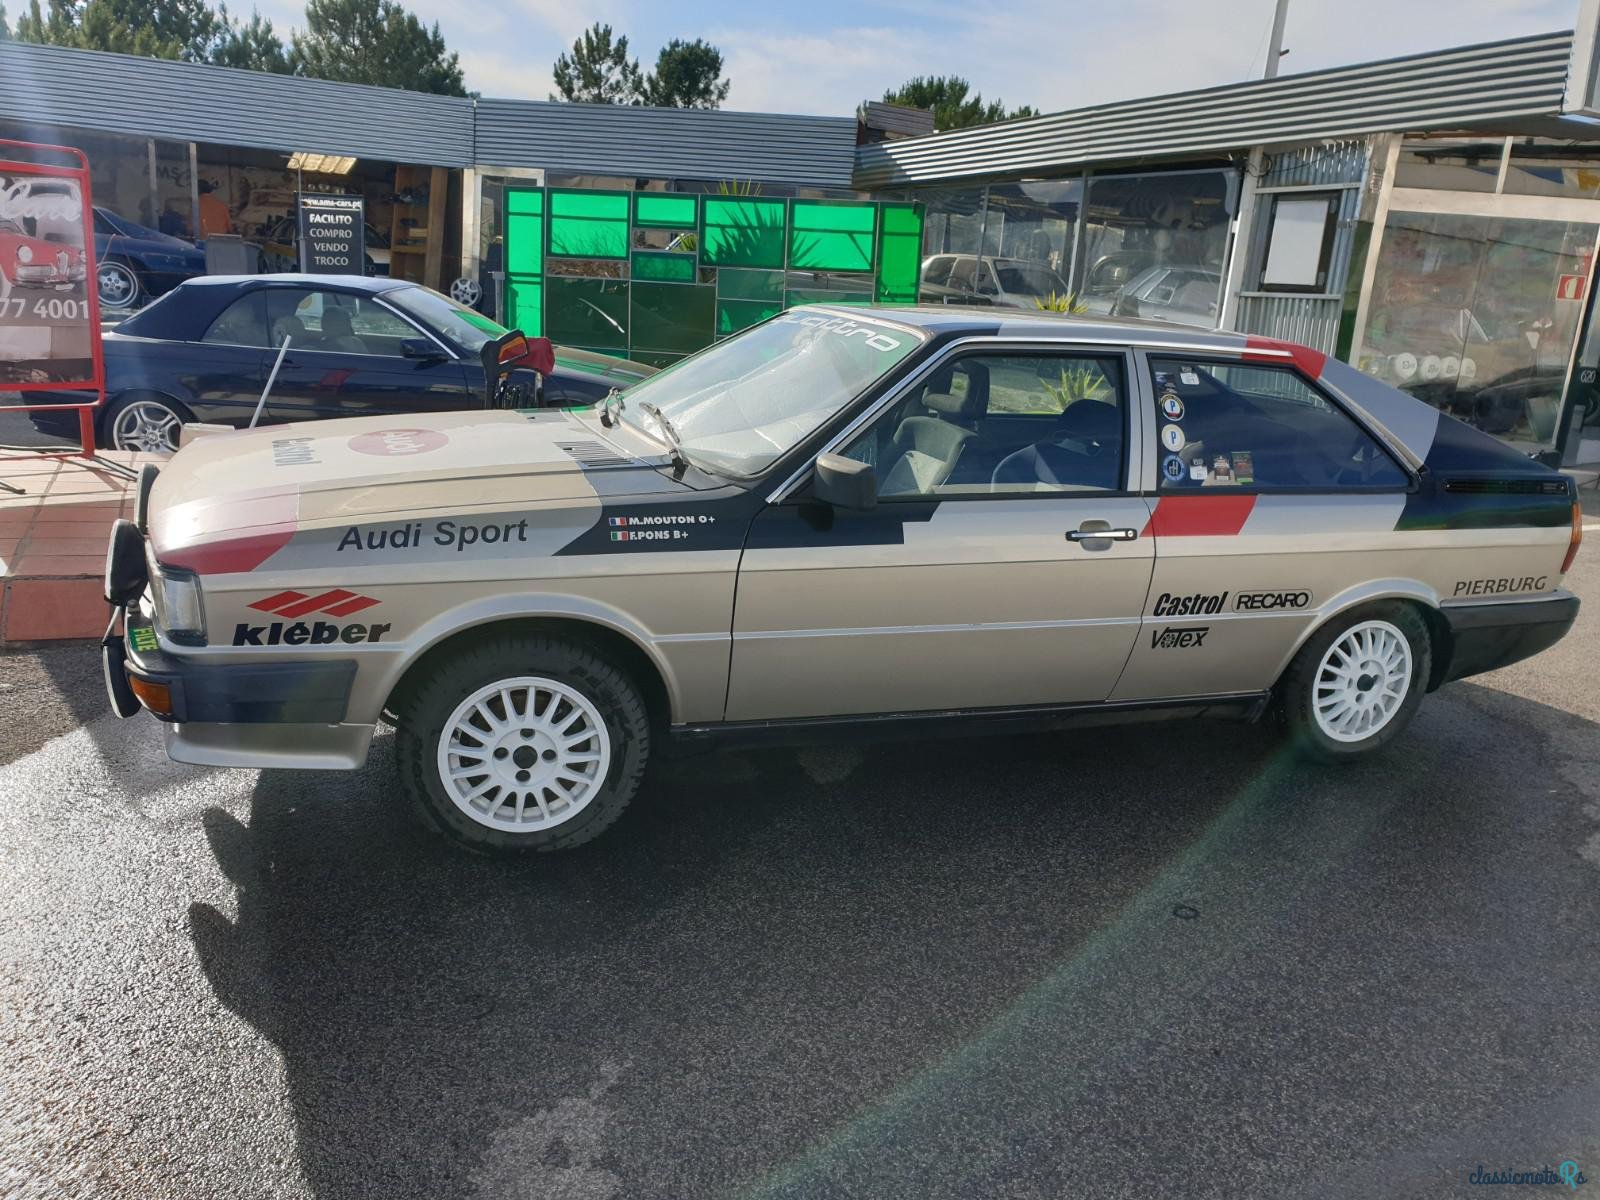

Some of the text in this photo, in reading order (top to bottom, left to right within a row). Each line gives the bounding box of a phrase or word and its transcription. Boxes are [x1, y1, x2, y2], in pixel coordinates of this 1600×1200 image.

[309, 213, 353, 225] FACILITO
[309, 228, 353, 239] COMPRO
[314, 242, 349, 252] VENDO
[314, 256, 349, 266] TROCO
[33, 299, 89, 320] 4001
[1580, 369, 1597, 384] 620
[628, 515, 696, 525] M.MOUTON
[336, 519, 528, 552] Audi Sport
[629, 530, 670, 541] F.PONS
[1453, 575, 1548, 597] PIERBURG
[1153, 591, 1309, 617] Castrol RECARO
